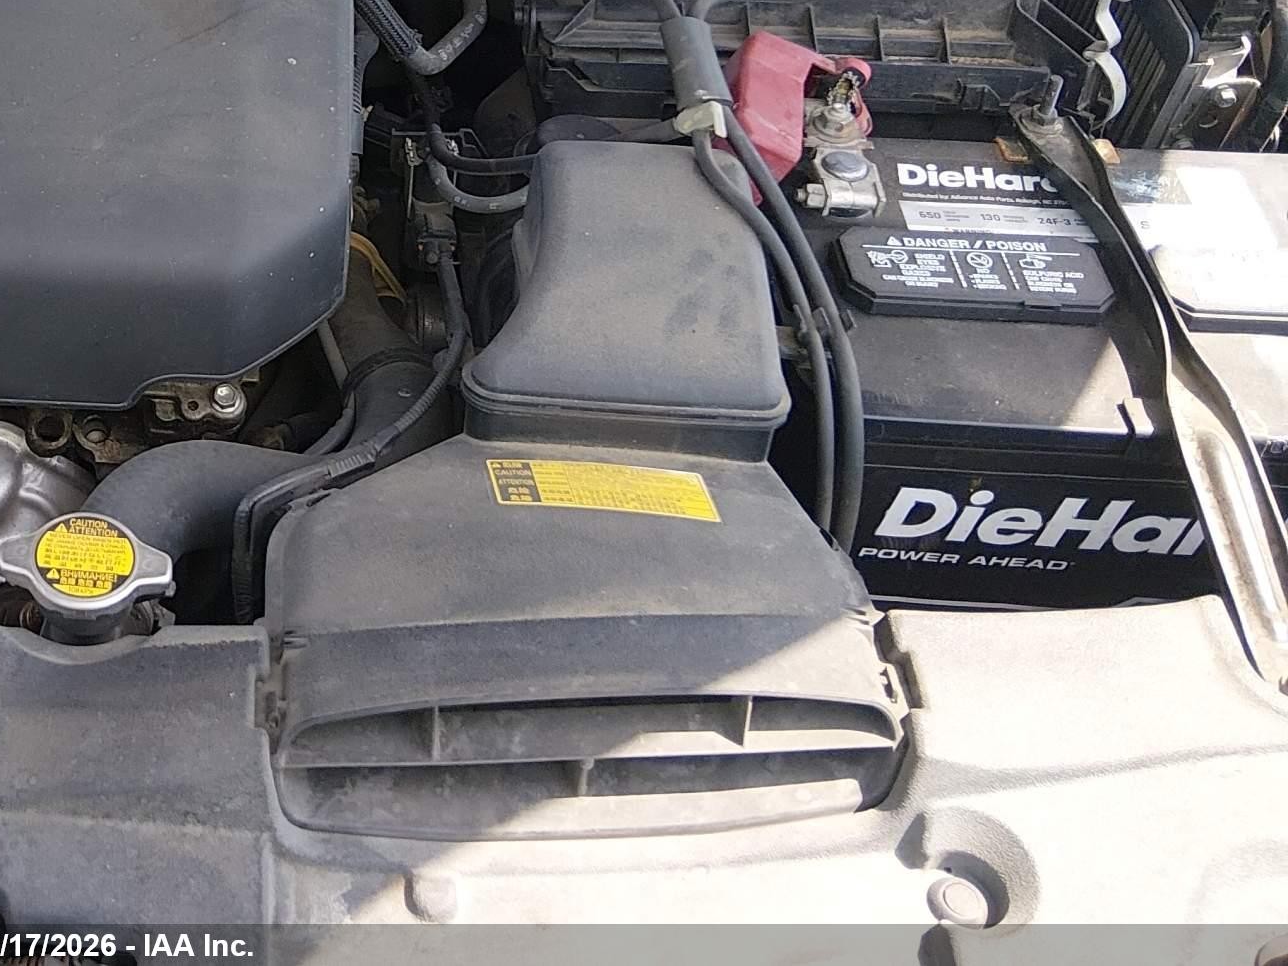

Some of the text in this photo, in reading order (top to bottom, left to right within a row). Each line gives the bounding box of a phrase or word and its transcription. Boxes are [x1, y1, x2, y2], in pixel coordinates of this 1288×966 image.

[902, 237, 970, 249] DANGER
[985, 240, 1047, 252] POISON
[495, 468, 532, 477] CAUTION
[69, 518, 108, 529] CAUTION
[68, 527, 118, 538] ATTENTION
[858, 547, 1070, 571] POWER AHEAD
